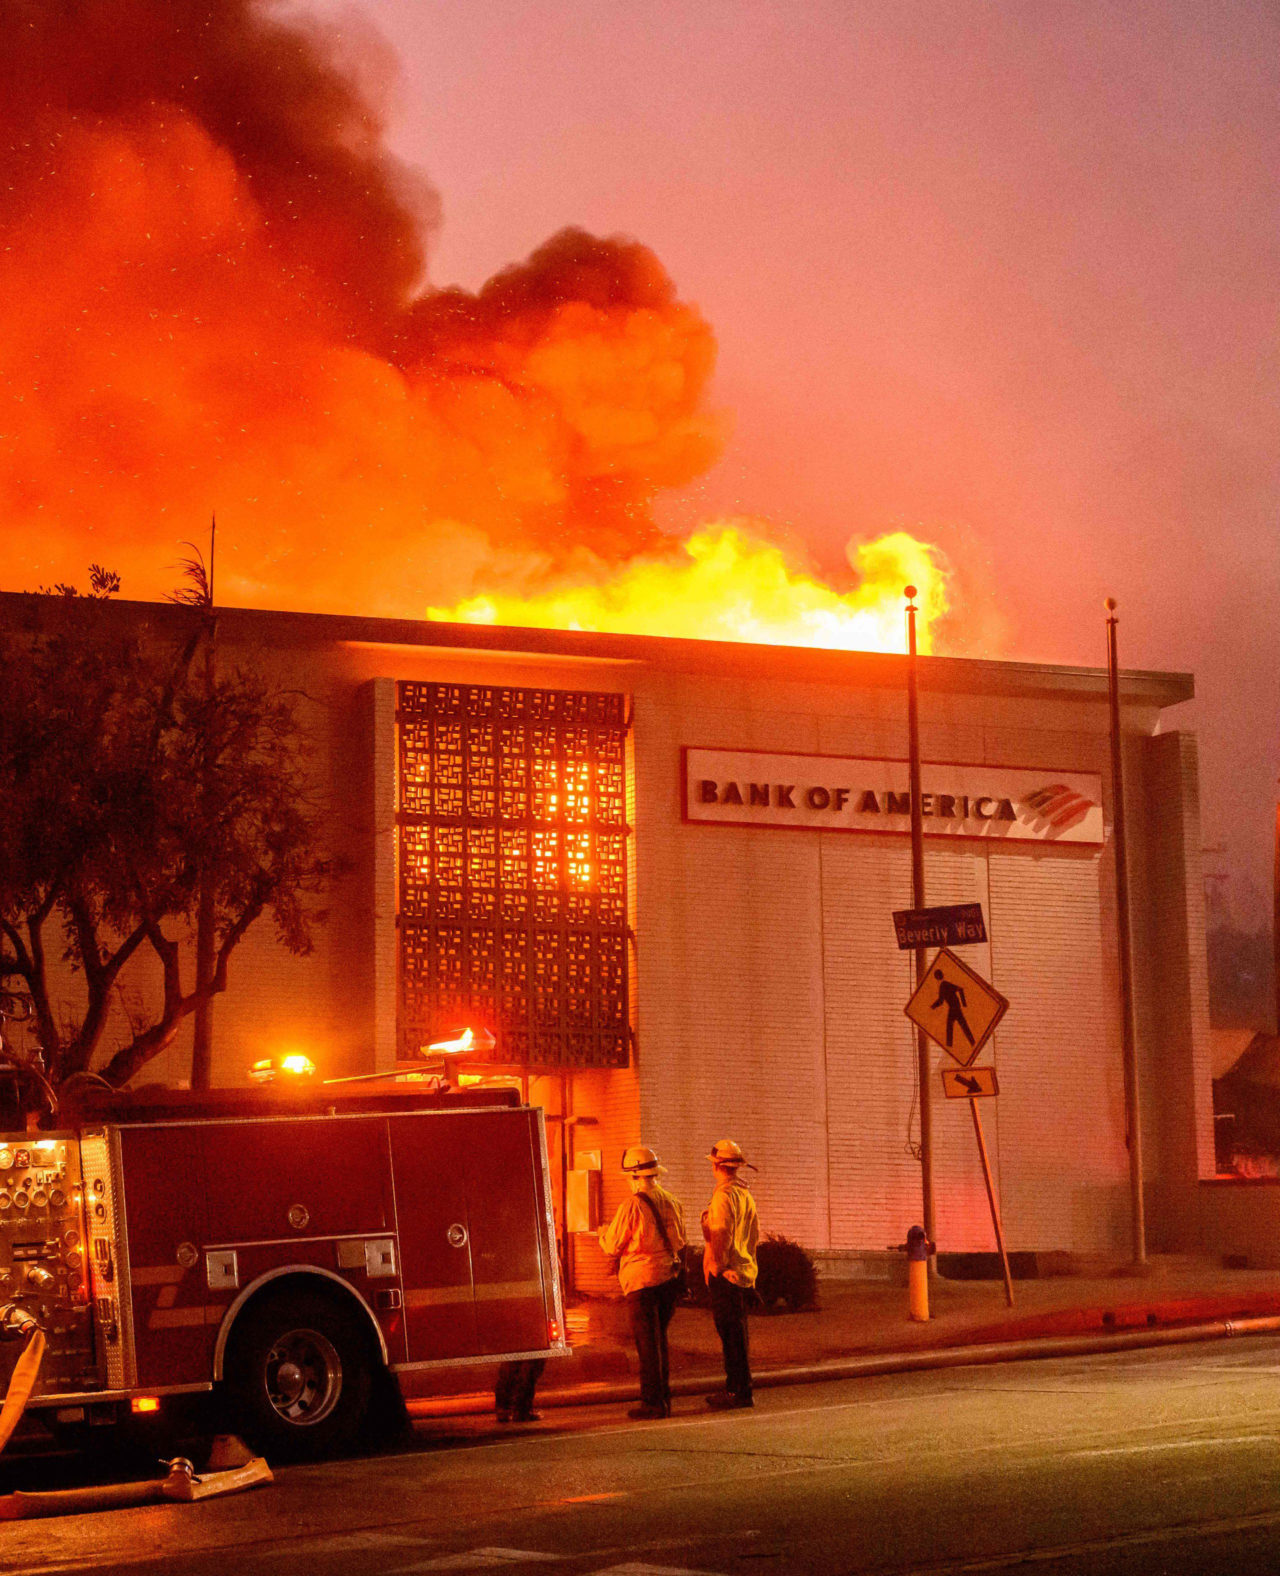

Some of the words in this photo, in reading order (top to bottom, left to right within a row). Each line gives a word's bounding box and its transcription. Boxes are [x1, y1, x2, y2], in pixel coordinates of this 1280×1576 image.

[698, 779, 796, 811] BANK
[807, 785, 850, 813] OF
[858, 789, 1018, 822] AMERICA
[897, 925, 948, 946] Beverly
[955, 920, 983, 939] Way
